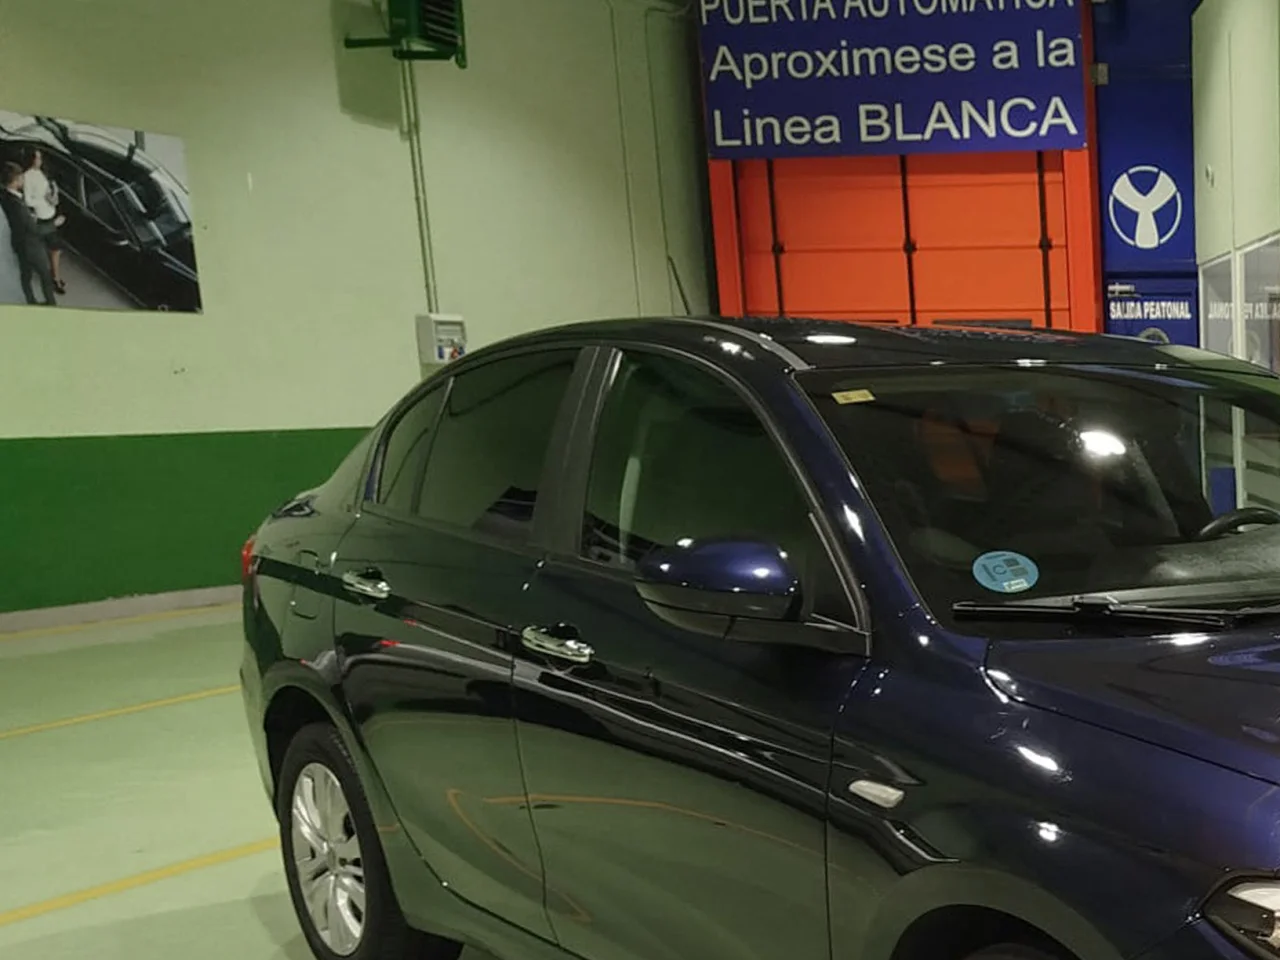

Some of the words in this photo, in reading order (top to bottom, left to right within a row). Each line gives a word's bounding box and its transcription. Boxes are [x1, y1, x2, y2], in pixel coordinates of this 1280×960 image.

[709, 40, 976, 89] Aproximese
[992, 40, 1019, 70] a
[1036, 29, 1076, 68] la
[714, 108, 841, 146] Linea
[858, 96, 1078, 143] BLANCA
[1109, 301, 1142, 320] SALIDA
[1143, 301, 1192, 320] PEATONAL
